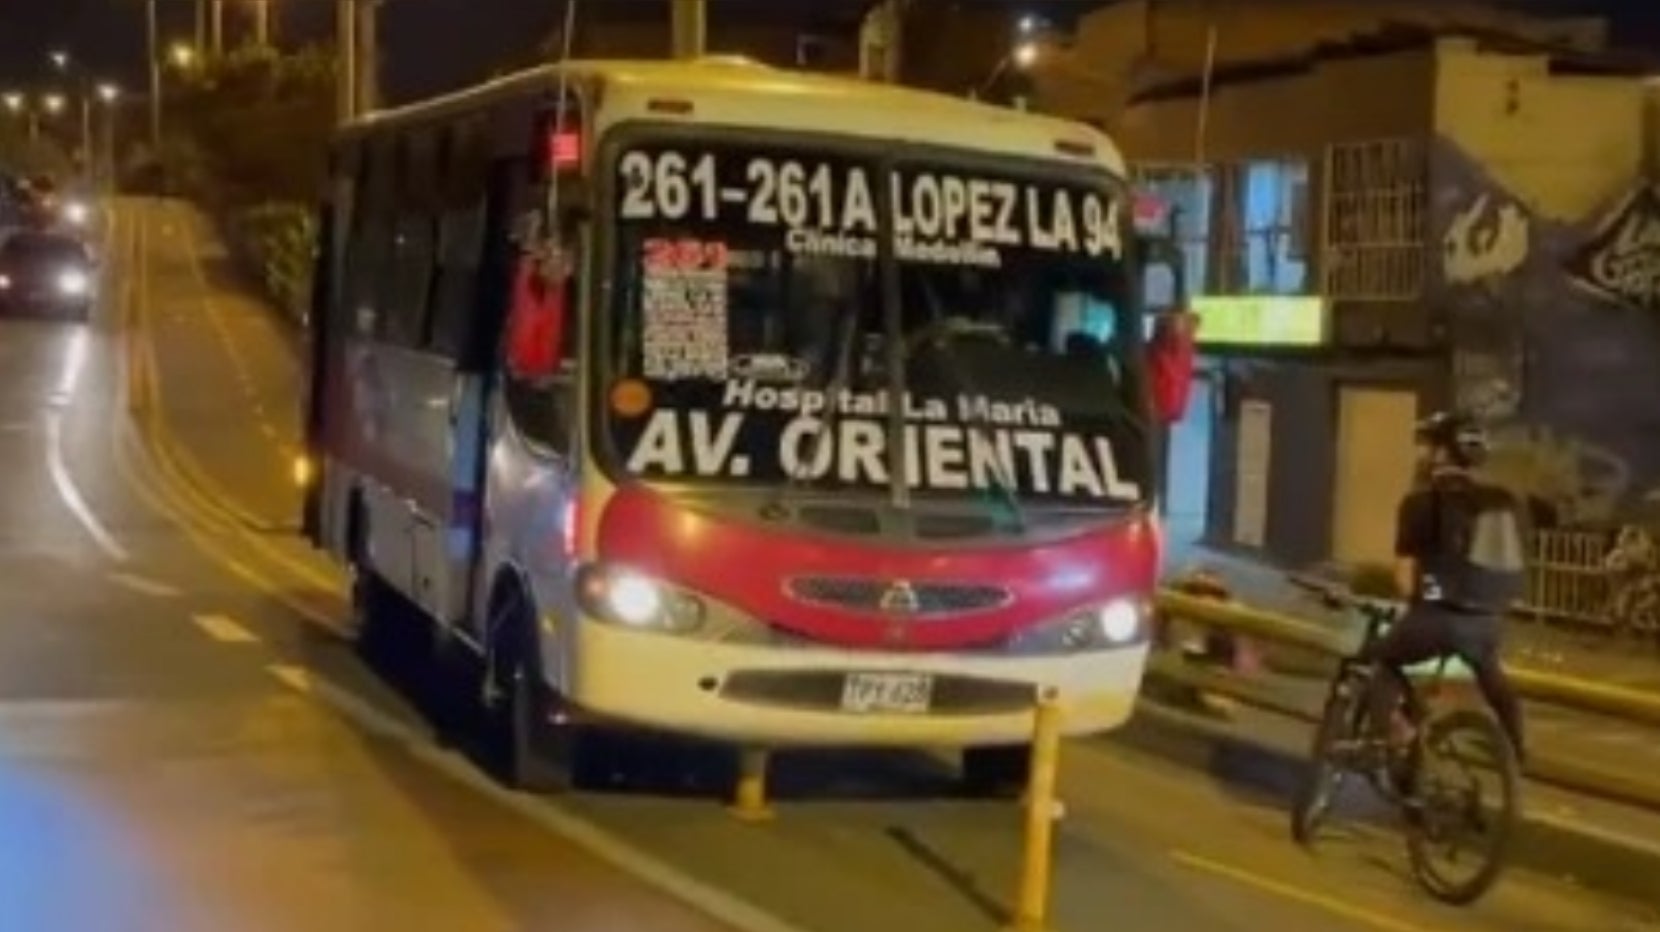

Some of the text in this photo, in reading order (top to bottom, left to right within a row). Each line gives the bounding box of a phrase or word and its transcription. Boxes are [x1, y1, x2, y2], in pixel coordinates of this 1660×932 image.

[619, 150, 1122, 260] 261-261A LOPEZ LA 94
[903, 390, 948, 421] La
[626, 409, 1140, 500] AV. ORIENTAL
